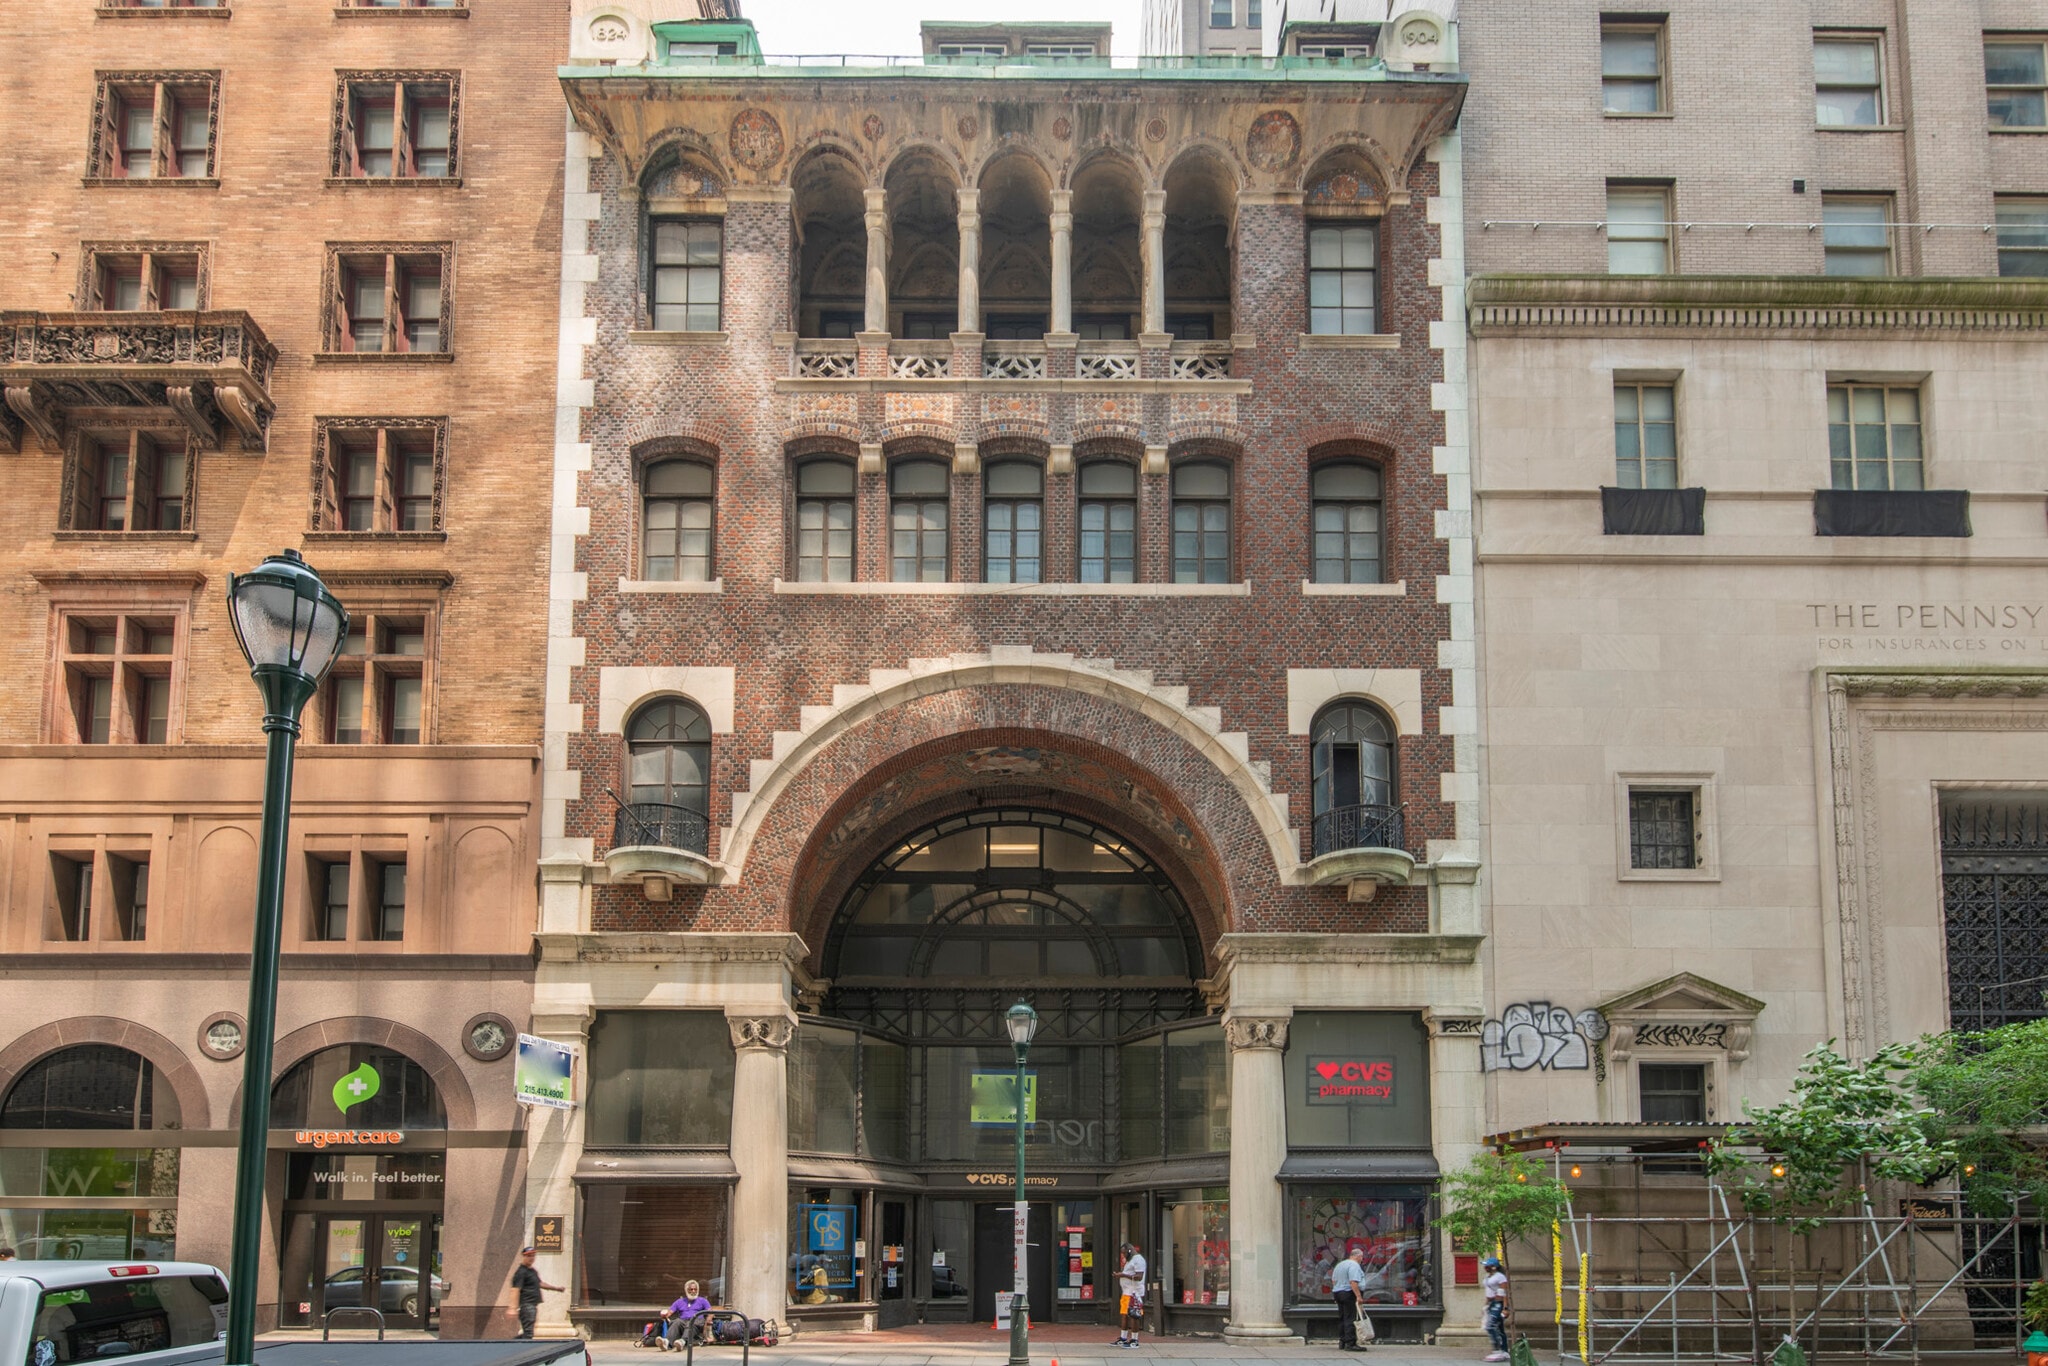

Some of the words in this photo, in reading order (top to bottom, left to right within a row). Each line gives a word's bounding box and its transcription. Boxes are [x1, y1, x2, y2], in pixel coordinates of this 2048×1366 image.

[1402, 31, 1439, 47] 1904
[1806, 604, 1880, 628] THE
[1897, 604, 2043, 629] PENNSY
[1818, 637, 1854, 650] FOR
[1868, 638, 1987, 651] INSURANCES
[2001, 639, 2027, 650] ON
[1341, 1062, 1393, 1081] CVS
[524, 1085, 564, 1099] 215.413.4900
[1319, 1083, 1391, 1099] pharmacy
[296, 1130, 355, 1148] urgent
[358, 1131, 401, 1144] care
[314, 1172, 348, 1183] Walk
[352, 1172, 368, 1183] in.
[372, 1172, 398, 1183] Feel
[401, 1171, 443, 1183] better.
[980, 1173, 1007, 1184] CVS
[1008, 1175, 1058, 1186] parmacy
[333, 1227, 357, 1237] vybe
[387, 1227, 412, 1238] vybe
